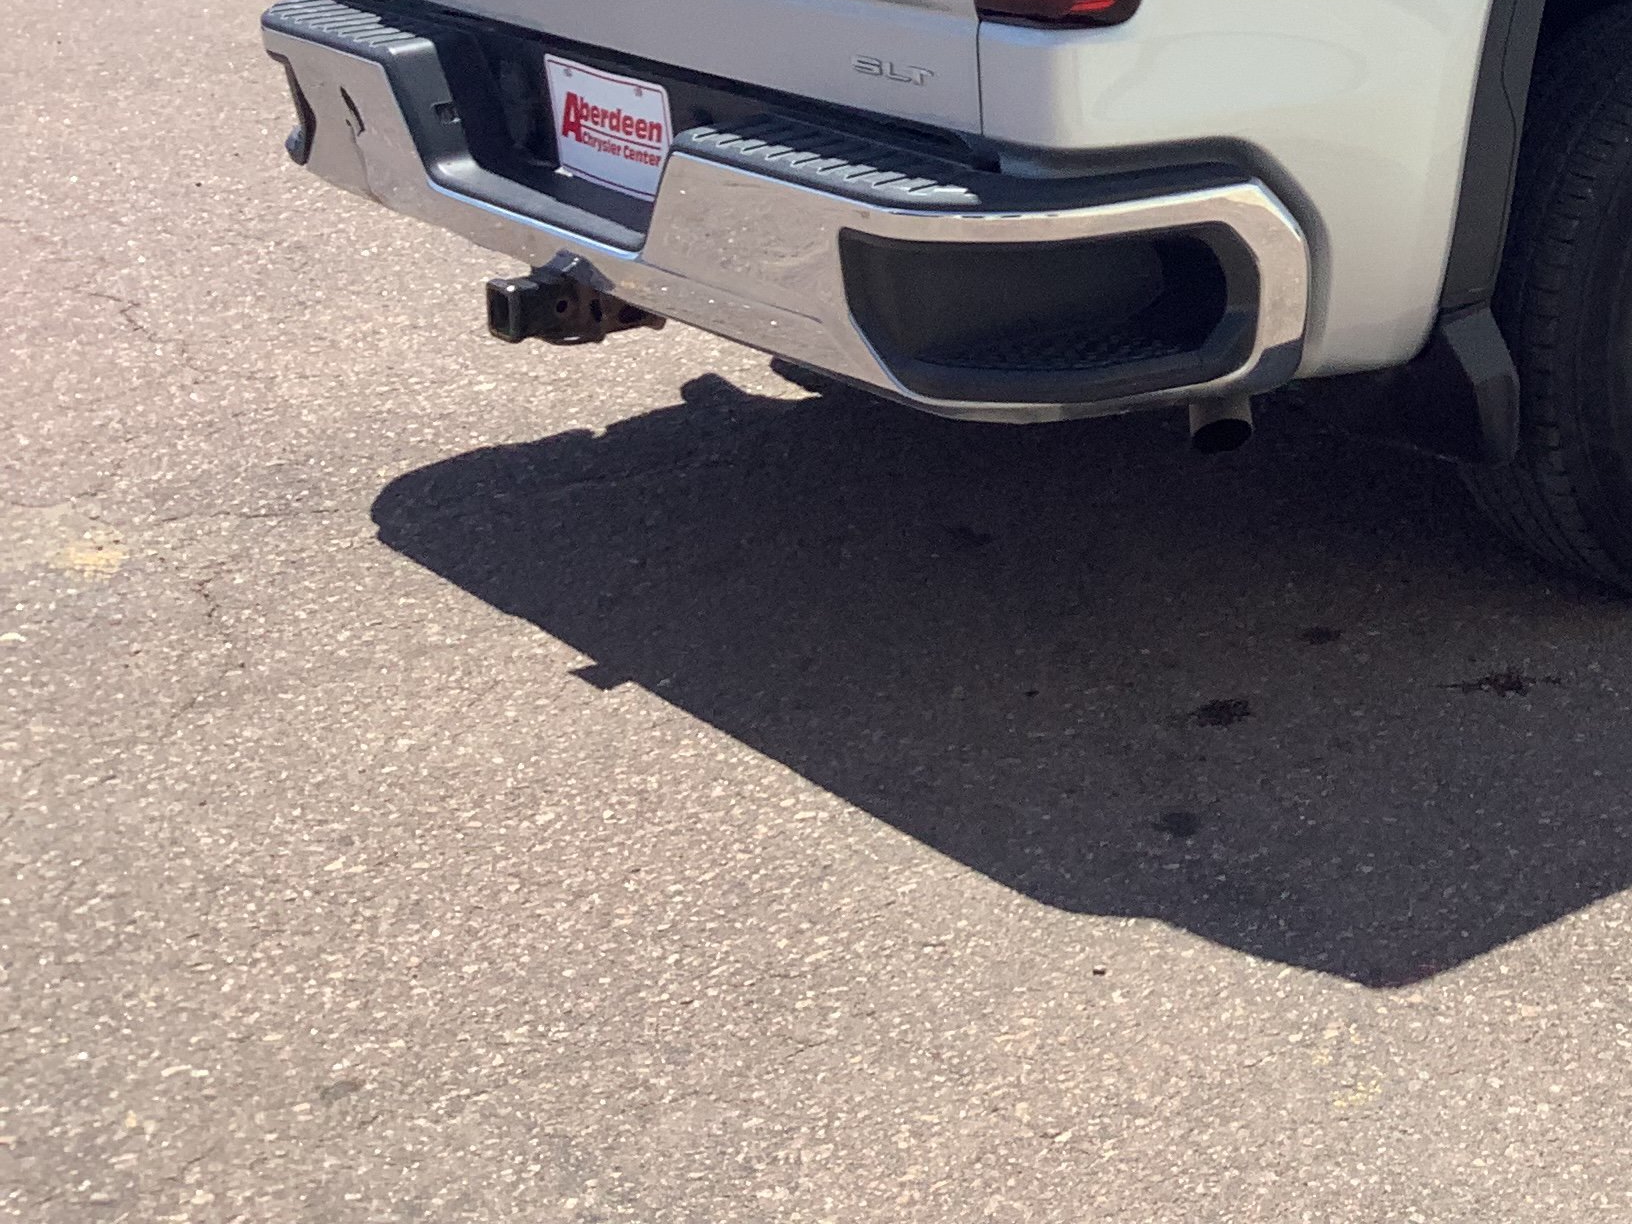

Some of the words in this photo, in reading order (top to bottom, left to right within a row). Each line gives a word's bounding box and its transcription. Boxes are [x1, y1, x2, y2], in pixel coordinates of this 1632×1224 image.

[851, 54, 935, 86] SLT
[562, 91, 662, 143] Aberdeen
[582, 130, 621, 156] Chrysler
[623, 145, 661, 167] Center
